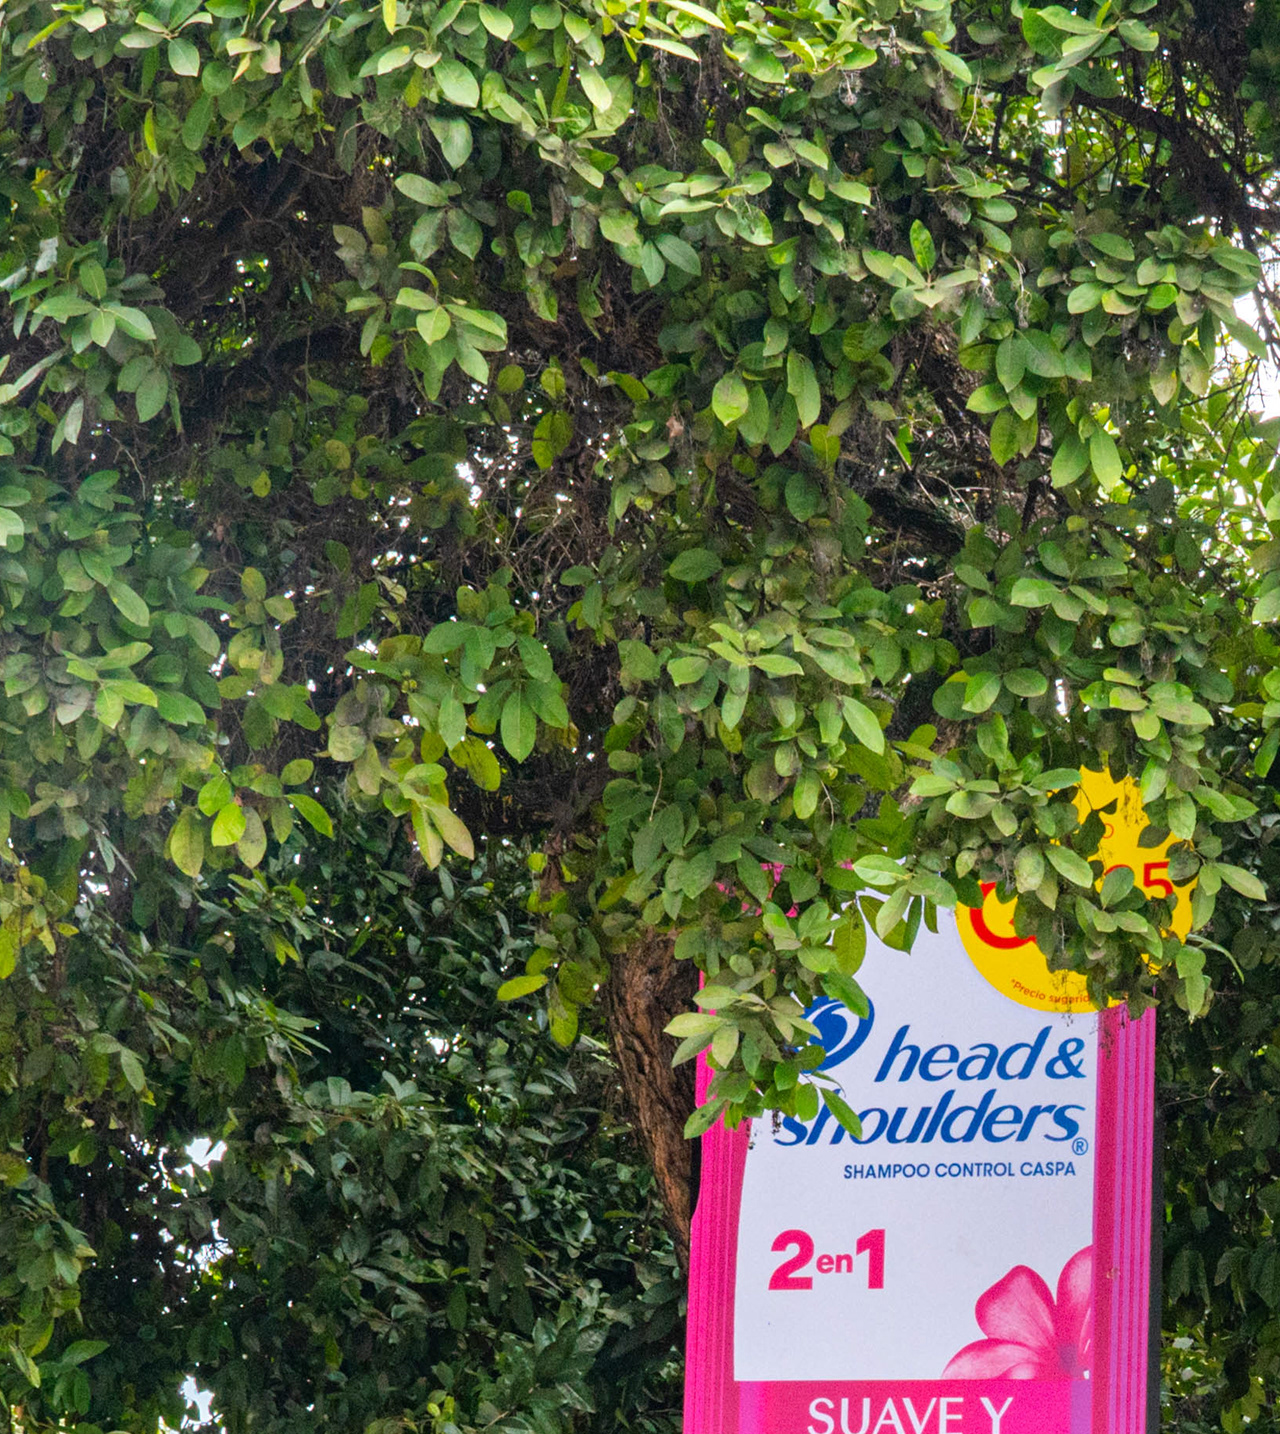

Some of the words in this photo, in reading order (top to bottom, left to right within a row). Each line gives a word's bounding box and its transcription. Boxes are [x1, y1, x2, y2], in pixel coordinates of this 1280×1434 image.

[1048, 993, 1090, 1005] sugerid
[843, 1162, 931, 1180] SHAMPOO
[934, 1162, 1016, 1179] CONTROL
[1019, 1161, 1077, 1178] CASPA
